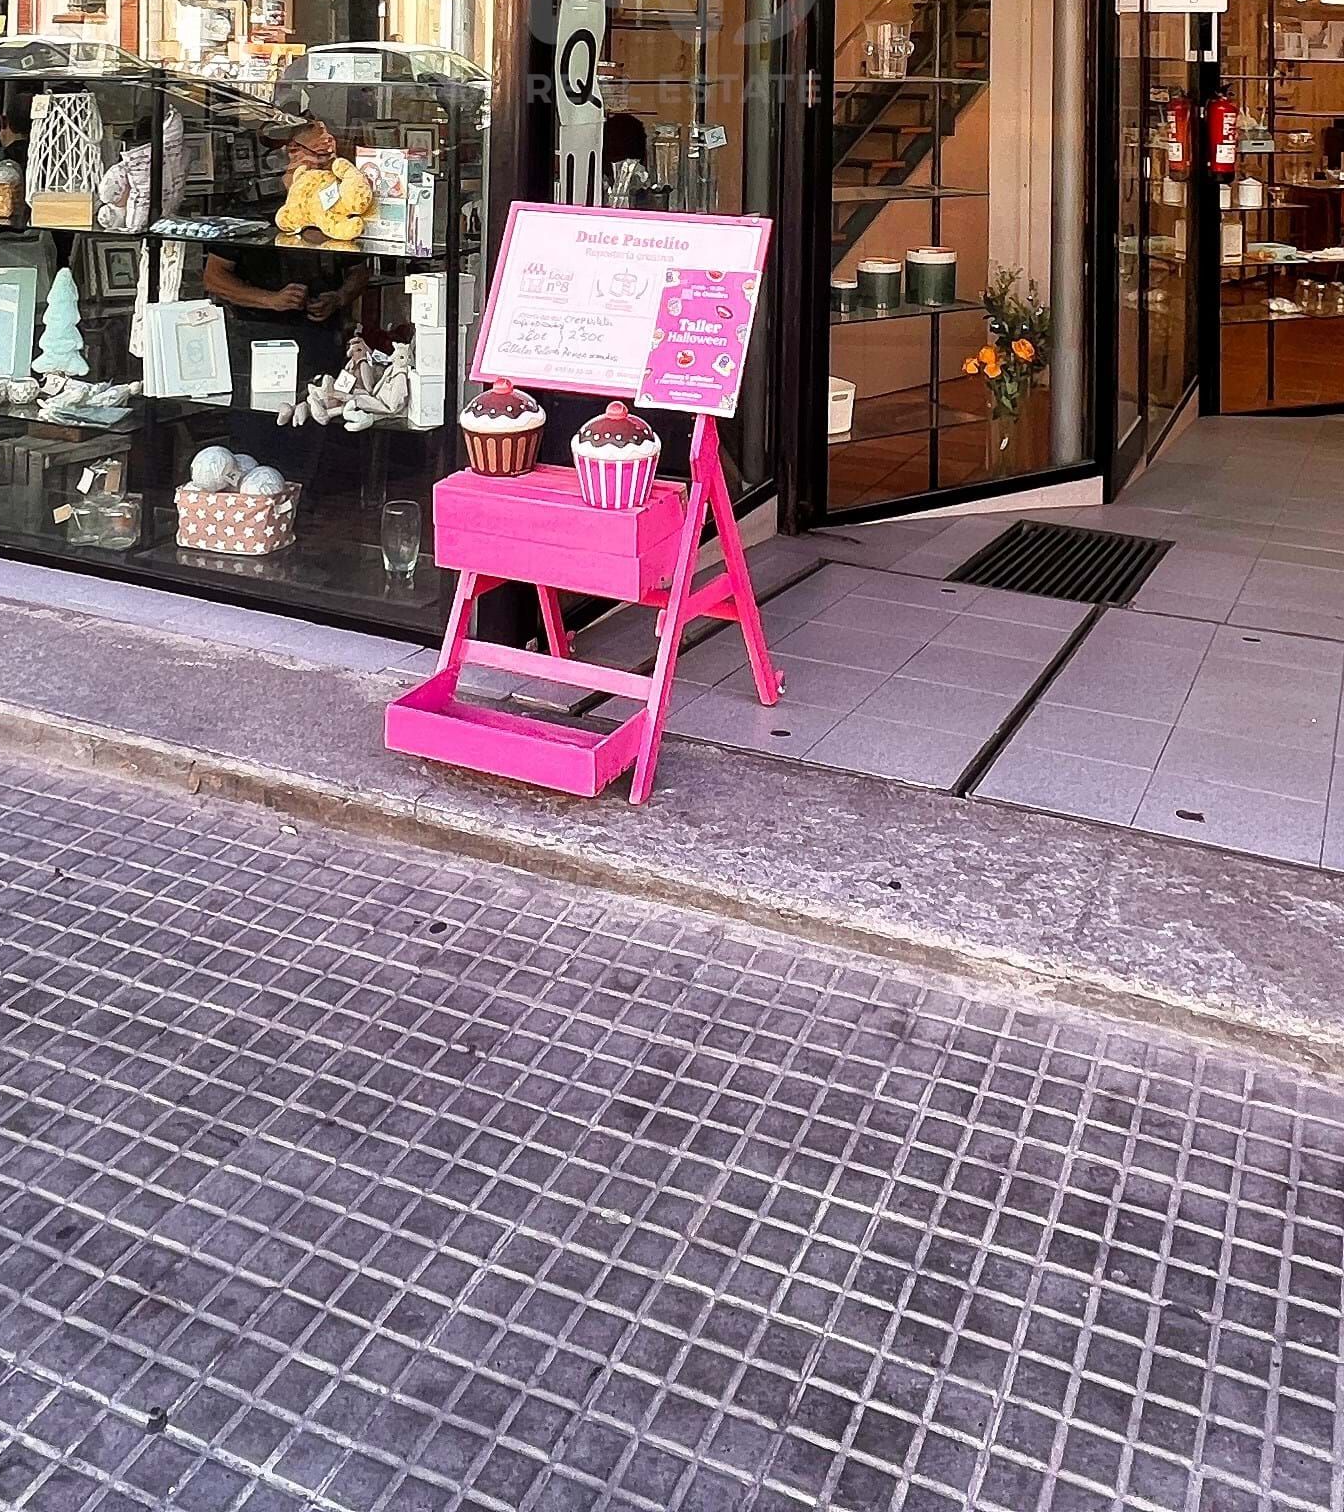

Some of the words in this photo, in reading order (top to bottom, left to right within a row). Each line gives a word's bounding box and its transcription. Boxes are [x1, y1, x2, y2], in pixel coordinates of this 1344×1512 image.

[575, 230, 619, 246] Dulce
[622, 234, 690, 252] Pastelito
[548, 271, 574, 282] Local
[678, 318, 723, 334] Taller
[667, 331, 728, 347] Halloween
